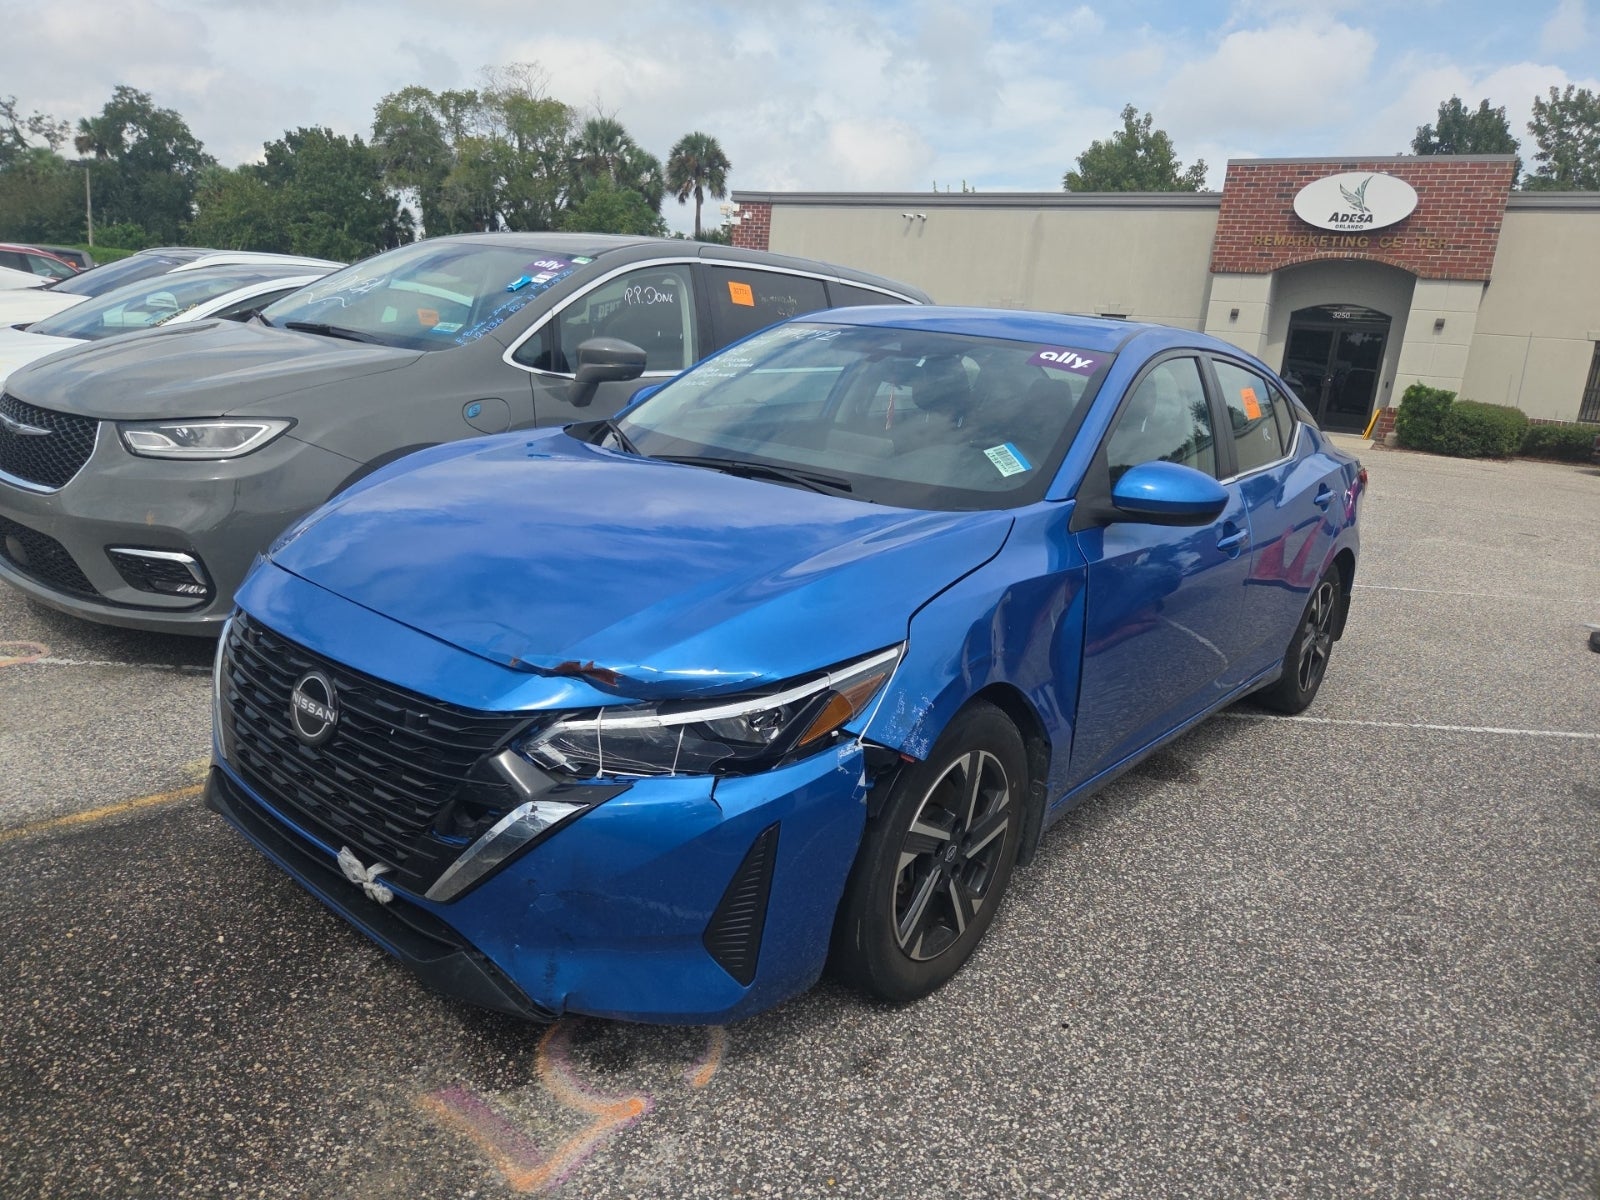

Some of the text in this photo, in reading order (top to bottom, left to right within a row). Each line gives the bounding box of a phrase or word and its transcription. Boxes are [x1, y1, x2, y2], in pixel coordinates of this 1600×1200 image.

[1327, 212, 1374, 224] ADESA
[1253, 234, 1450, 250] REMARKETING CETER
[1332, 311, 1351, 319] 3250
[1039, 350, 1095, 370] ally
[291, 689, 336, 723] NISSAN
